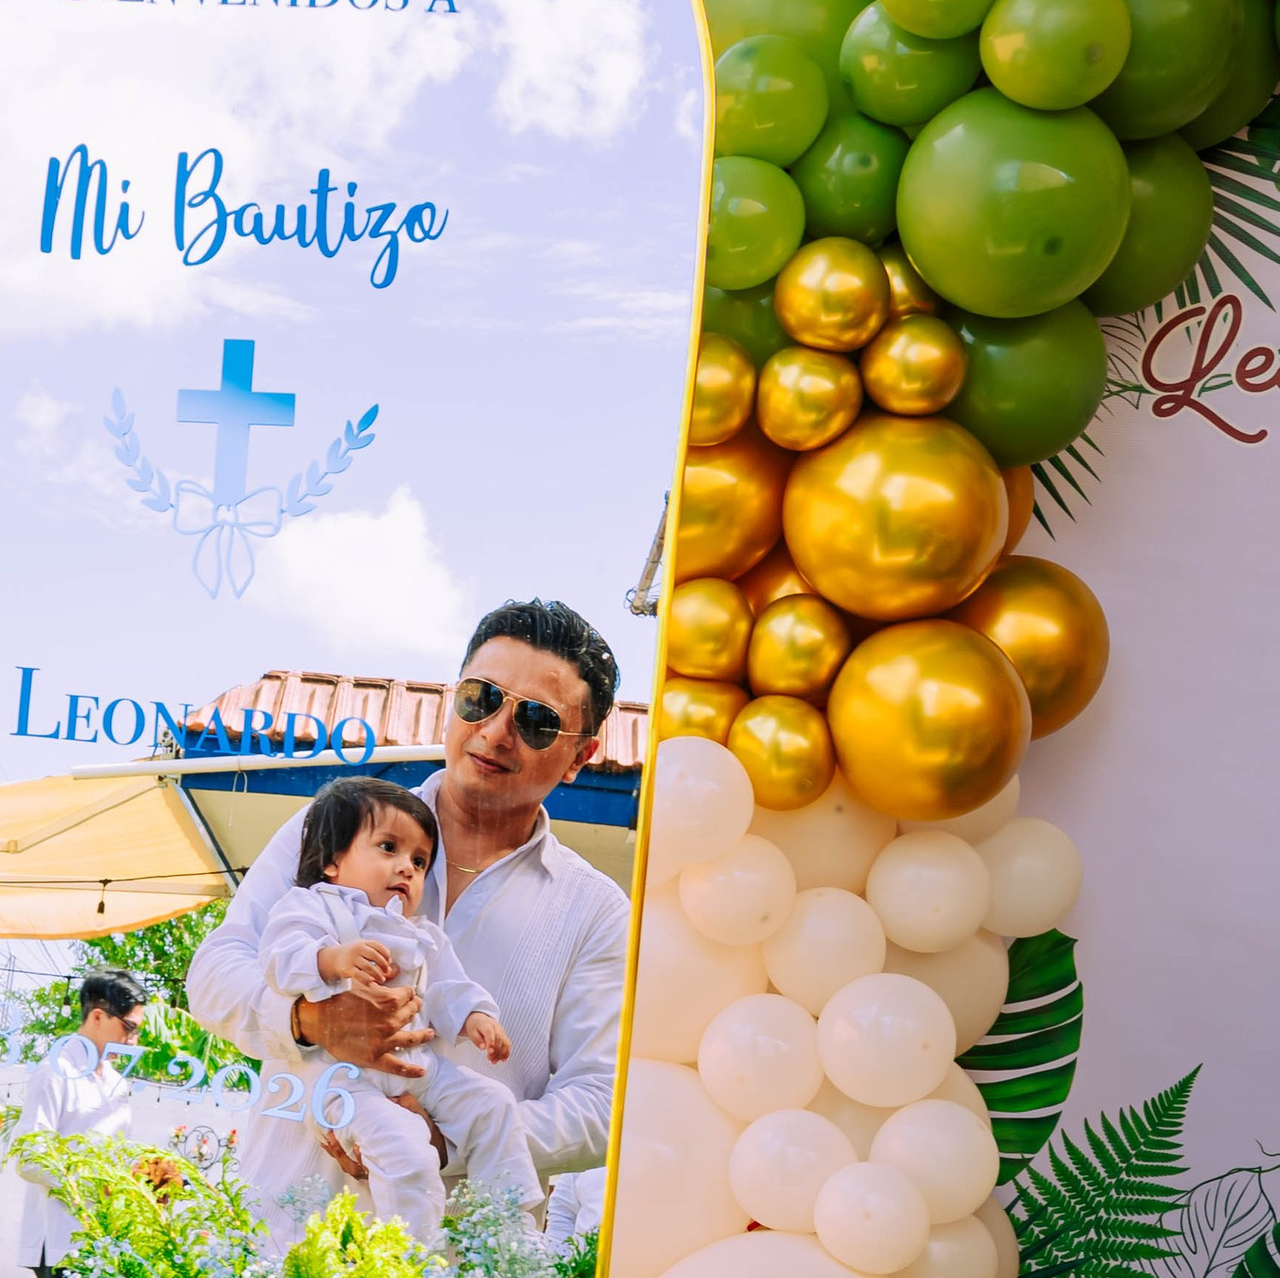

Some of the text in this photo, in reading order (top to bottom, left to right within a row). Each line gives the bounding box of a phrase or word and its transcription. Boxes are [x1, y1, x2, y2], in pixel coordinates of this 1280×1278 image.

[40, 144, 449, 289] Mi Bautizo
[1141, 294, 1280, 444] Le
[9, 665, 376, 766] LEONARDO
